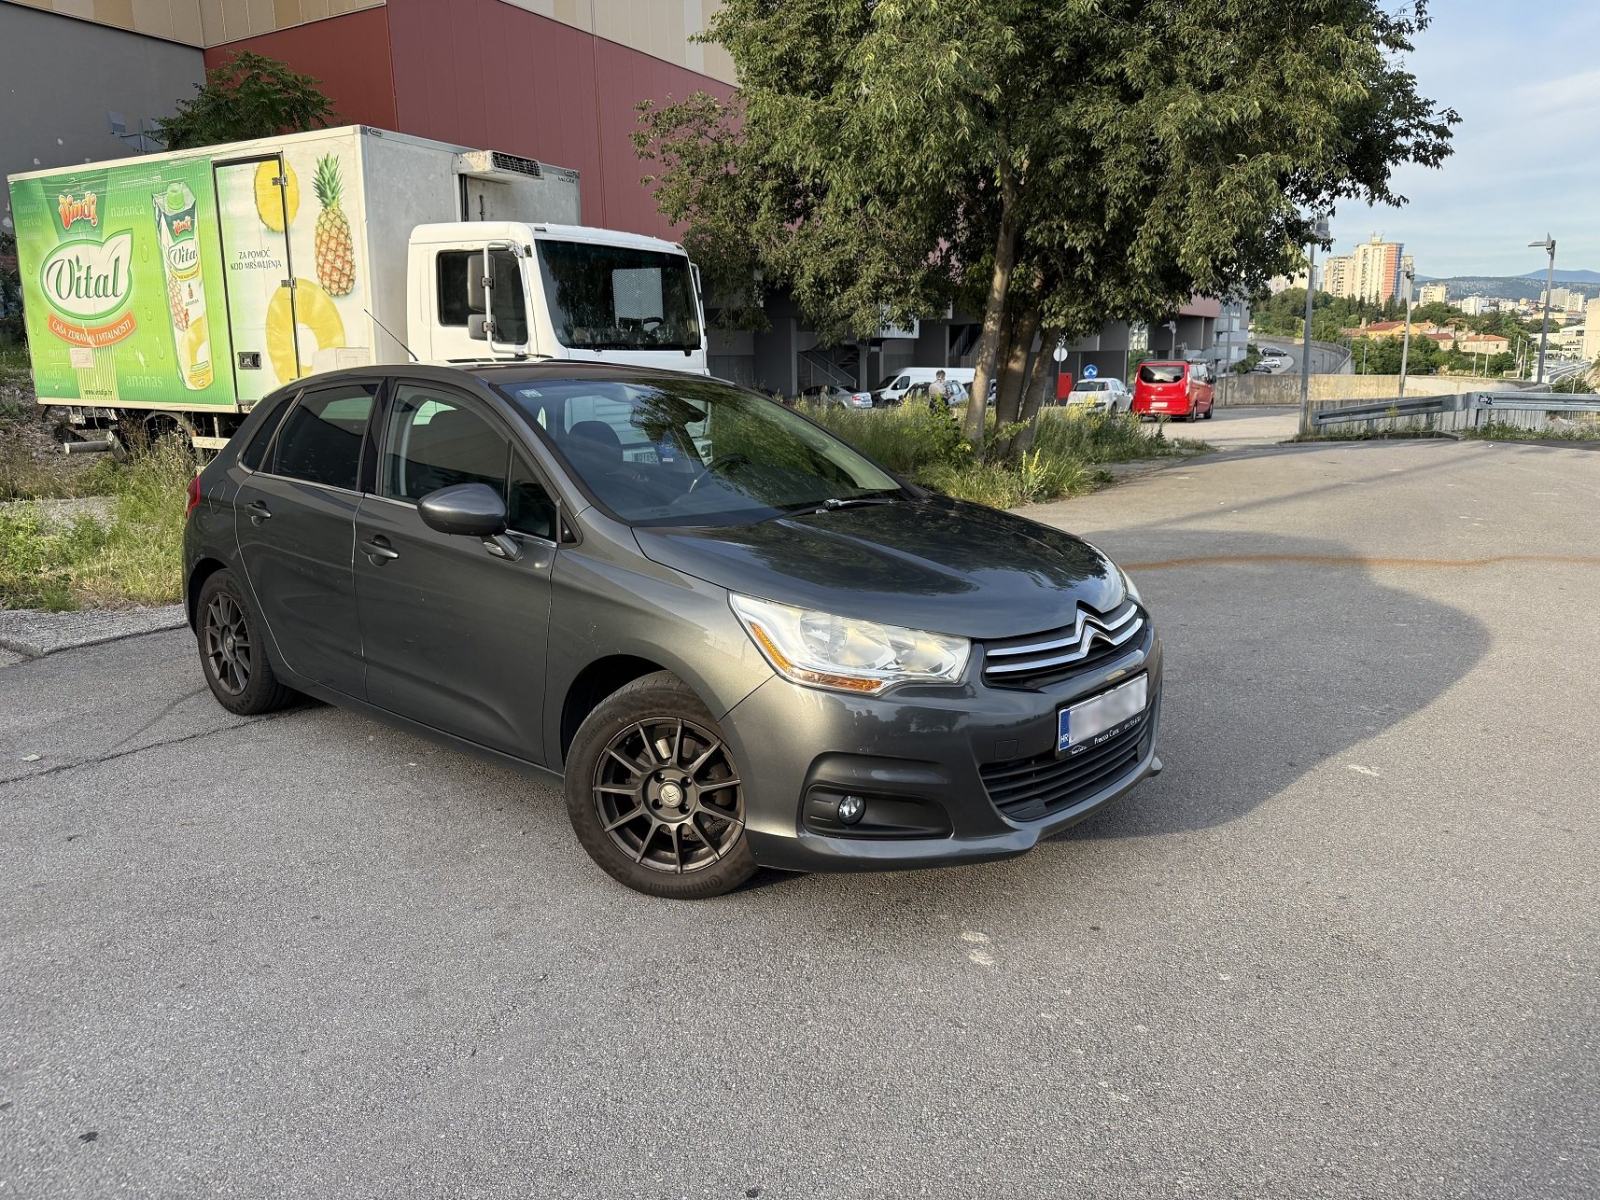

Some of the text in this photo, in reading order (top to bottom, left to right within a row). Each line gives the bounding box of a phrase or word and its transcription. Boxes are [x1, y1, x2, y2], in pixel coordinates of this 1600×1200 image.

[230, 262, 244, 271] KOD
[46, 254, 123, 301] Vital
[126, 375, 162, 388] ananas
[1060, 733, 1070, 743] HR
